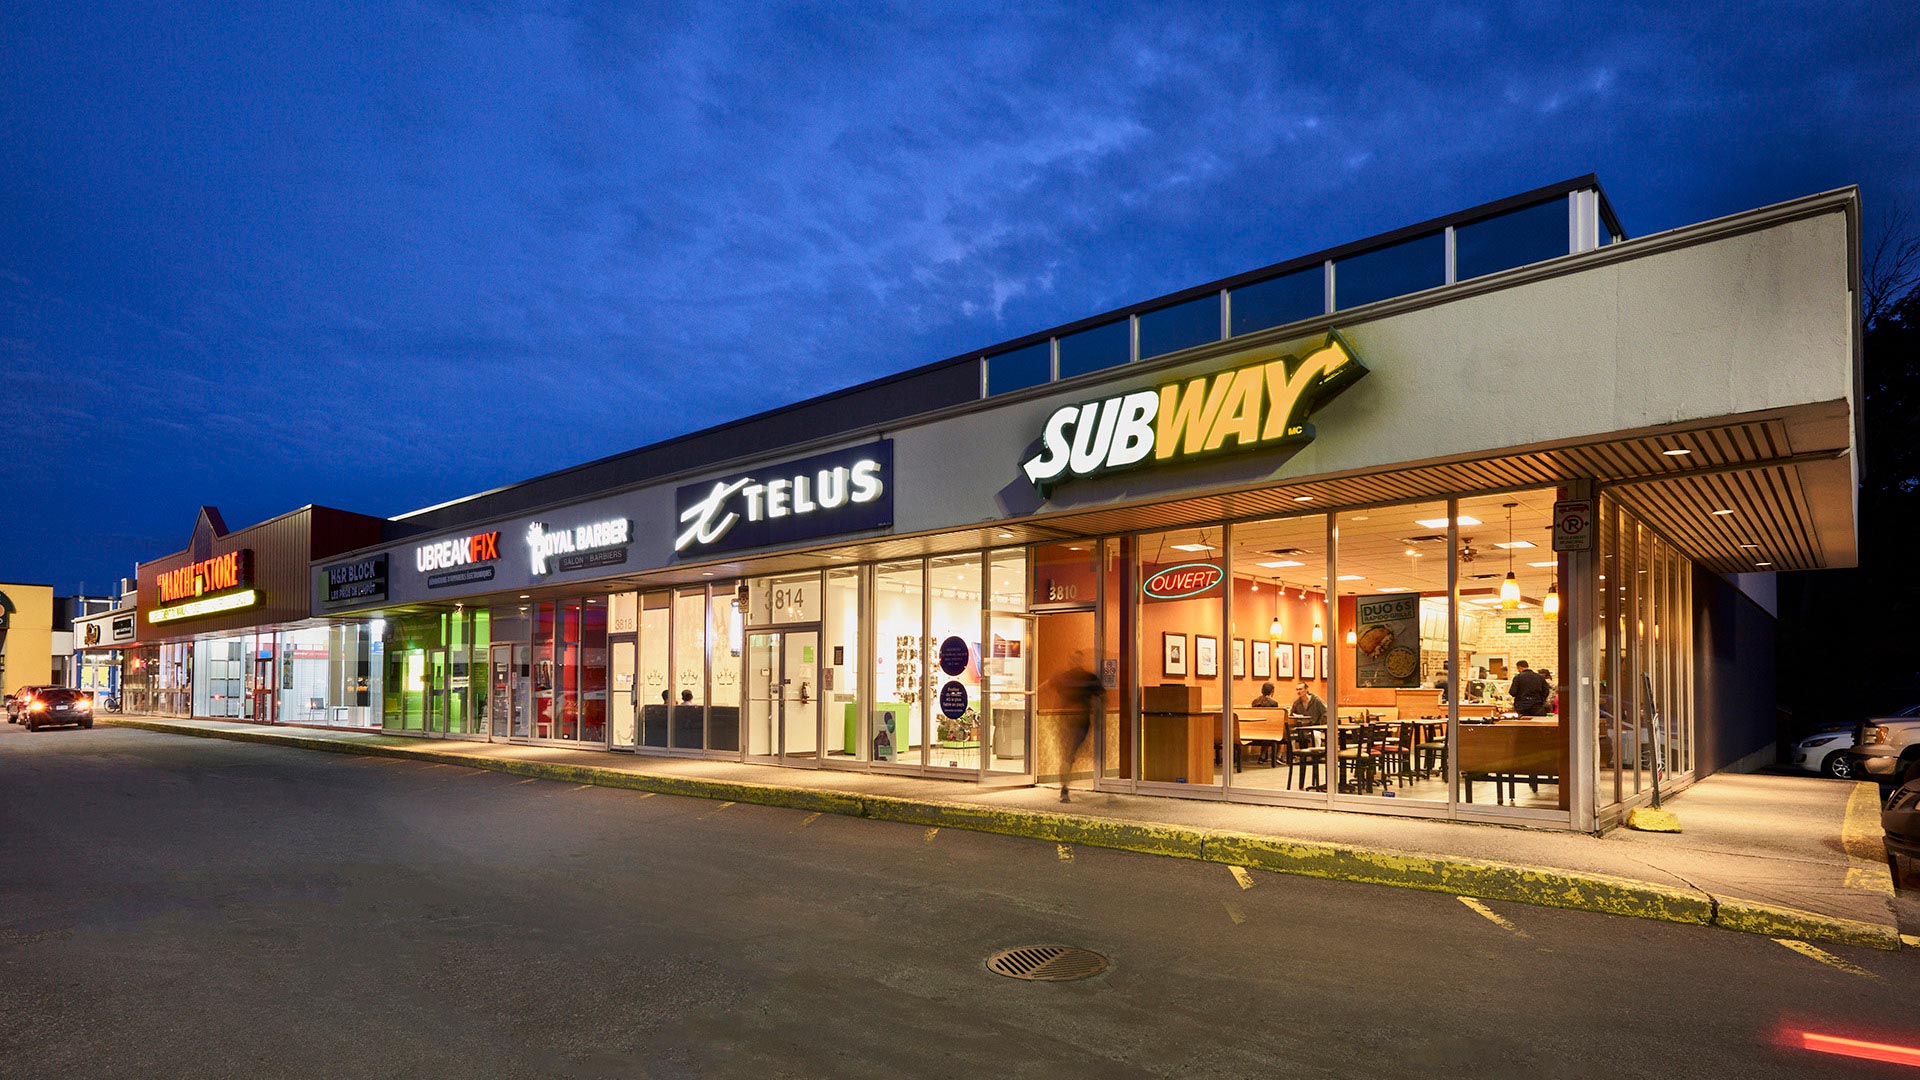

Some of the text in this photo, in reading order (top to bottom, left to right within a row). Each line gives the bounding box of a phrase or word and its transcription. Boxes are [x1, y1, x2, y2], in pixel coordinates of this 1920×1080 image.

[1023, 341, 1349, 484] SUBWAY MC
[742, 459, 884, 522] TELUS
[416, 531, 497, 572] UBREAKIFIX
[531, 518, 628, 575] ROYAL BARBER
[563, 556, 584, 566] SALON
[589, 550, 623, 562] BARBIERS
[161, 562, 196, 602] MARCHÉ
[203, 551, 239, 592] STORE
[348, 560, 375, 582] BLOCK
[1151, 570, 1217, 592] OUVERT
[764, 588, 804, 610] 3814
[1049, 584, 1077, 601] 3810
[1364, 604, 1393, 616] DUO
